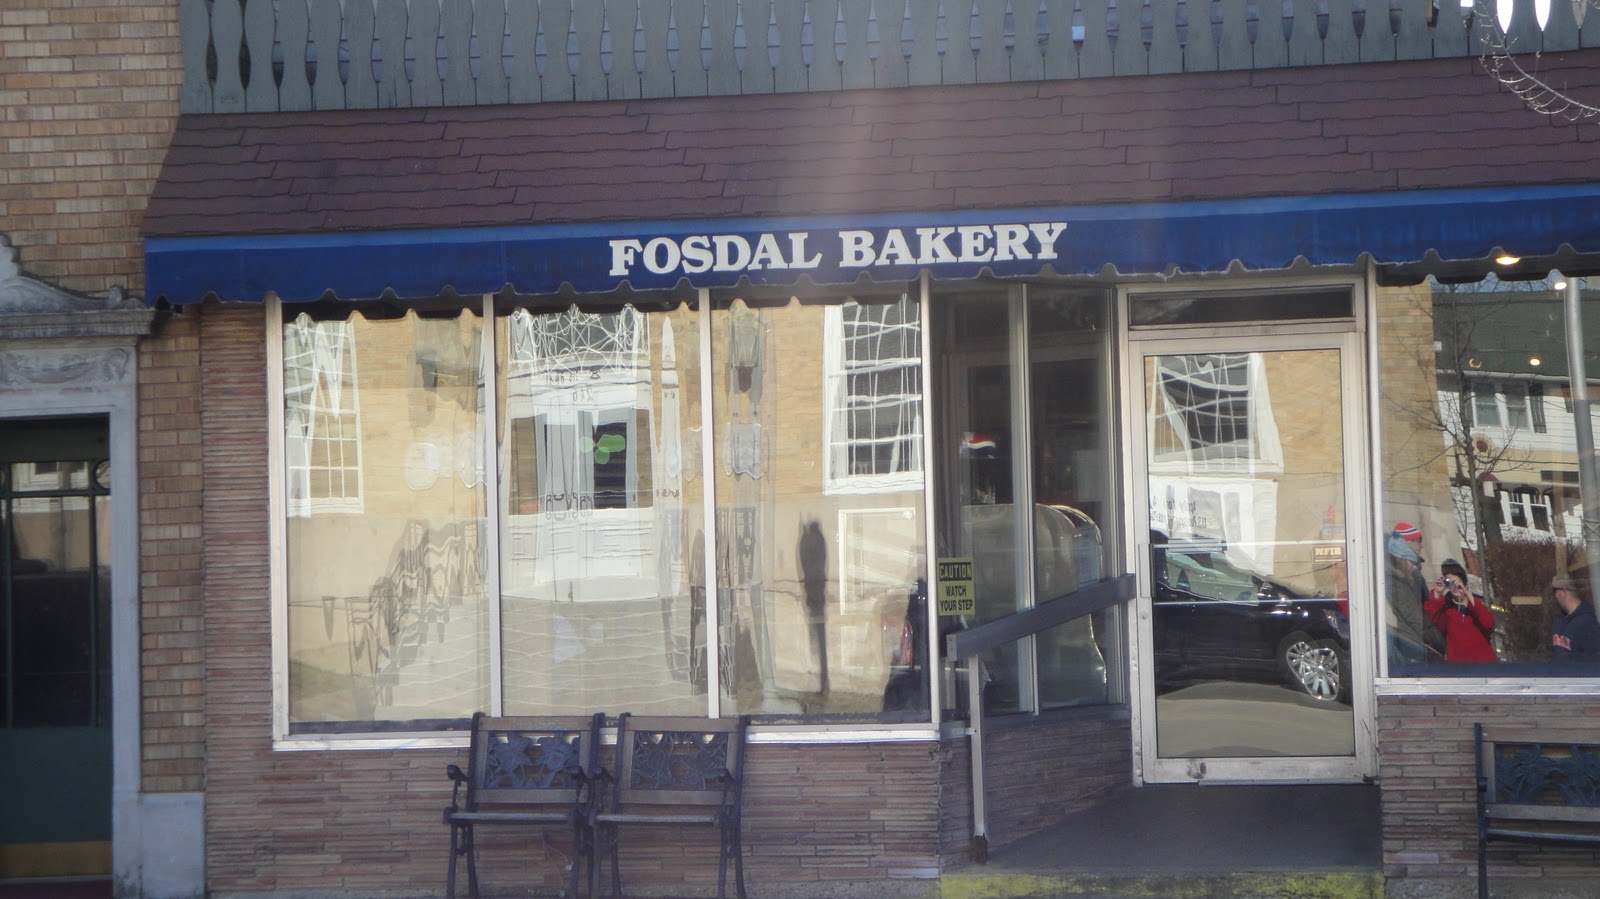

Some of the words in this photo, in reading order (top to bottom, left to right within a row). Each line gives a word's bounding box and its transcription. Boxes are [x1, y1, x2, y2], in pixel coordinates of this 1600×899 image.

[609, 232, 823, 276] FOSDAL
[838, 222, 1067, 267] BAKERY
[939, 564, 972, 579] CAUTION
[945, 585, 967, 597] WATCH
[940, 600, 957, 612] YOUR
[958, 599, 973, 611] STEP
